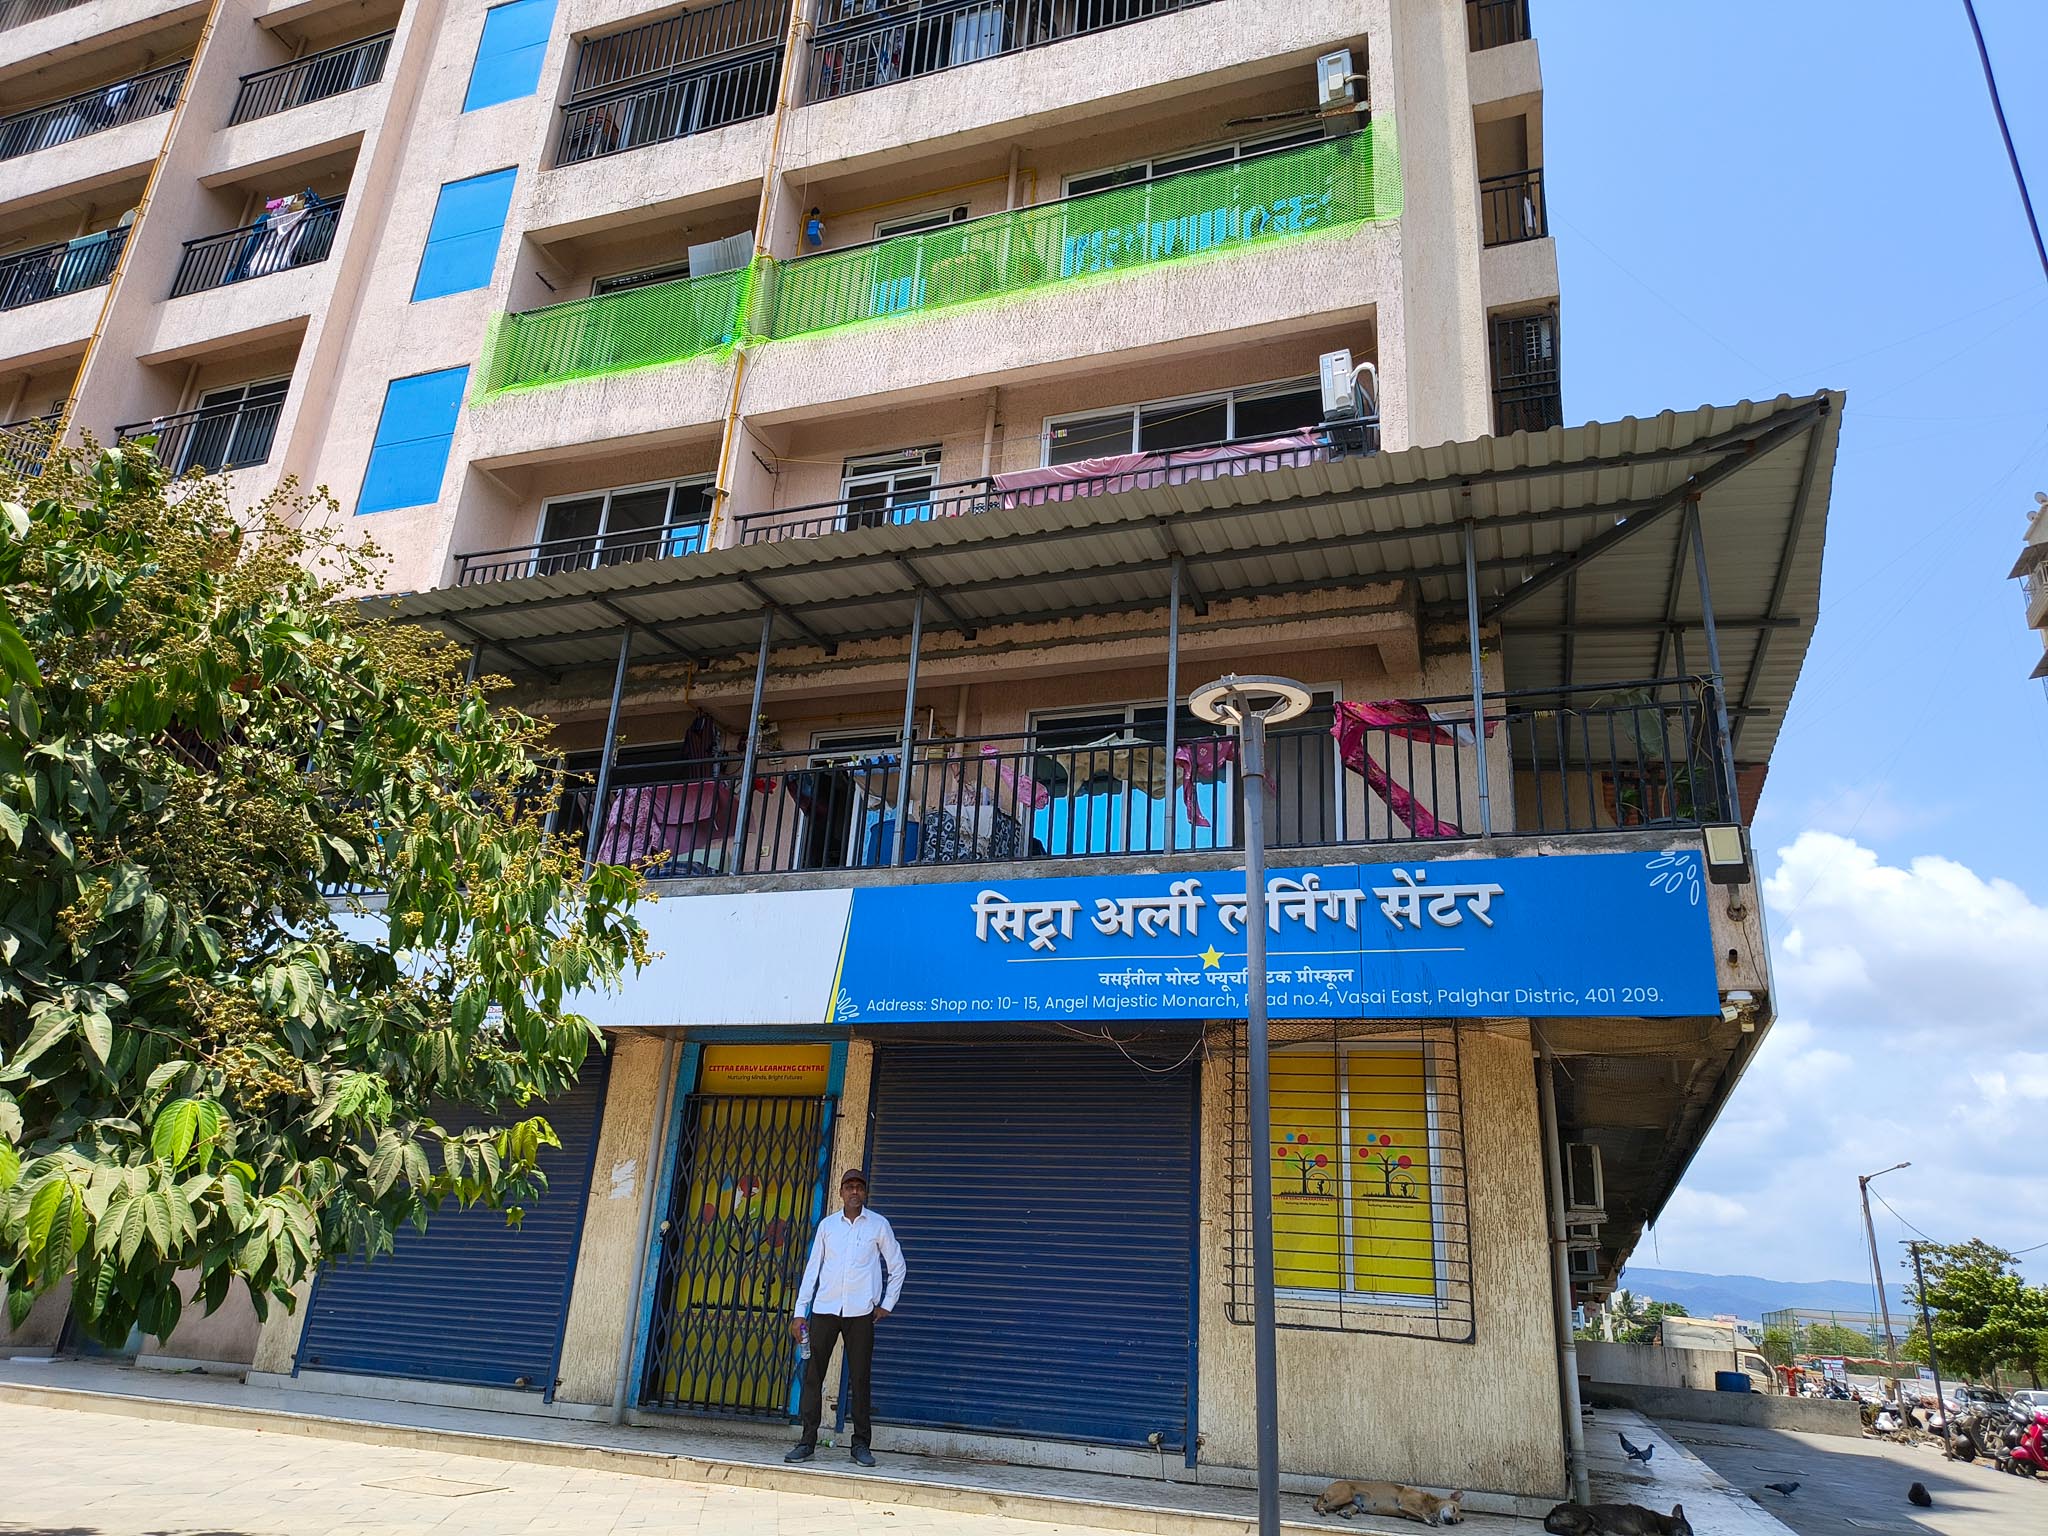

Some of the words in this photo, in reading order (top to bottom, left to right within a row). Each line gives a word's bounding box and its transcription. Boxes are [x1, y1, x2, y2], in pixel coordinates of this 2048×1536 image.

[970, 889, 1082, 951] सिट्रा
[1090, 878, 1206, 938] अर्ली
[1372, 868, 1504, 930] सेंटर
[1098, 968, 1162, 989] वसईतील
[1165, 968, 1201, 986] मोस्ट
[1295, 966, 1355, 990] प्रीस्कूल
[866, 998, 927, 1011] Address:
[930, 998, 967, 1014] Shop
[971, 999, 993, 1010] no:
[1023, 996, 1040, 1011] 15,
[1045, 995, 1087, 1013] Angel
[1092, 994, 1158, 1012] Majestic
[1162, 992, 1239, 1009] Monarch,
[1245, 991, 1288, 1006] ad
[1293, 991, 1333, 1007] no.4,
[1336, 990, 1386, 1004] Vasai
[1391, 989, 1433, 1006] East,
[1438, 988, 1510, 1007] Palghar
[1515, 988, 1579, 1005] Distric,
[1585, 988, 1616, 1003] 401
[1622, 987, 1664, 1003] 209.
